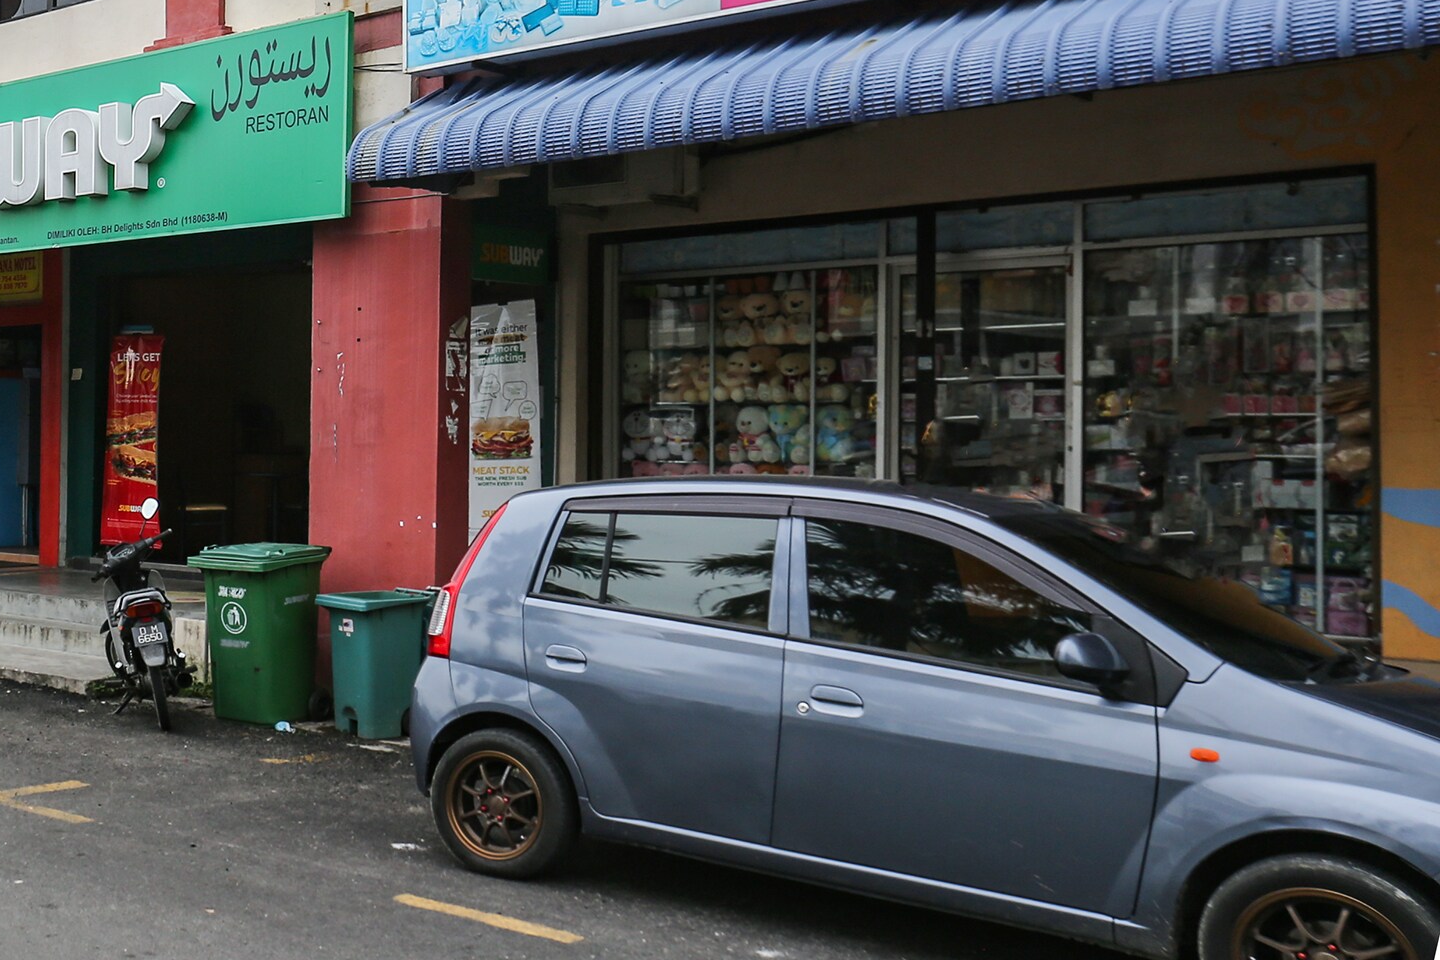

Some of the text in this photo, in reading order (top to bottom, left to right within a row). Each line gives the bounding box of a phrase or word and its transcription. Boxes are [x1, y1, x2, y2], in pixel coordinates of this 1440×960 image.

[210, 36, 332, 122] ريستورن
[244, 104, 329, 135] RESTORAN
[47, 211, 228, 240] DIMILIKI OLEH: BH Delights Sdn Bhd (1180638-M)
[480, 243, 544, 267] SUBWAY
[14, 256, 36, 271] MOTEL
[501, 324, 527, 333] either
[495, 345, 520, 353] more
[142, 352, 160, 362] GET
[472, 465, 530, 475] MEAT STACK
[118, 504, 142, 513] SUBWA
[137, 632, 163, 644] 6650
